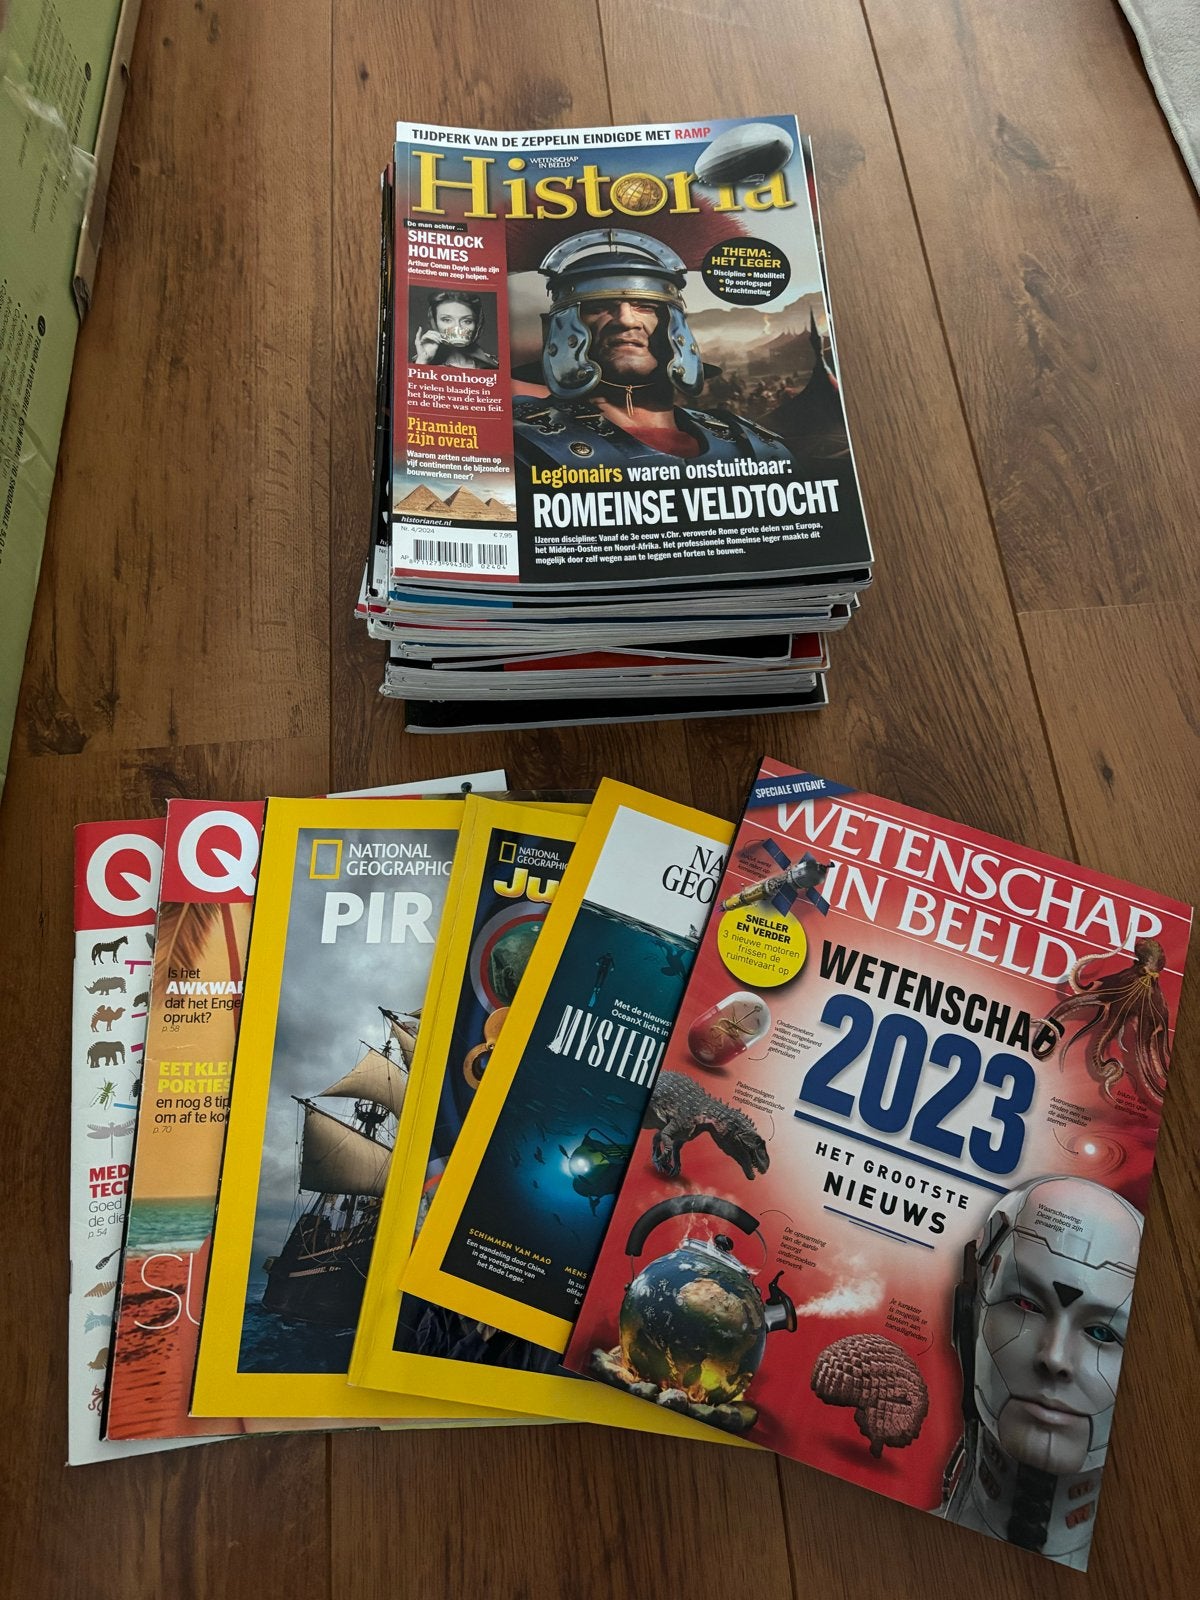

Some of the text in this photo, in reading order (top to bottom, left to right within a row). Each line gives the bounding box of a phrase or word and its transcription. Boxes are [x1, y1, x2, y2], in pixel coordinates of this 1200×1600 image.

[412, 127, 711, 147] TIJDPERK VAN DE ZEPPELIN EINDIGDE MET RAMP
[411, 150, 796, 220] Historia
[408, 230, 484, 249] SHERLOCK
[408, 245, 469, 262] HOLMES
[722, 247, 771, 258] THEMA:
[712, 257, 781, 269] HET LEGER
[714, 270, 746, 278] Discipline
[725, 279, 772, 288] Op oorlogspad
[726, 287, 771, 297] Krachtmeting
[408, 368, 497, 387] Pink omhoog!
[407, 390, 420, 398] het
[423, 391, 445, 401] kopje
[464, 395, 475, 403] de
[420, 383, 445, 392] vielen
[446, 386, 480, 396] blaadjes
[408, 417, 478, 436] Piramiden
[408, 431, 479, 449] zijn overal
[531, 458, 792, 489] Legionairs waren onstuitbaar:
[533, 479, 839, 528] ROMEINSE VELDTOCHT
[401, 516, 452, 526] historianet.nl
[534, 536, 560, 544] IJzeren
[561, 535, 598, 545] discipline:
[599, 534, 619, 542] Vanaf
[630, 533, 640, 541] 3e
[661, 531, 681, 539] v.Chr.
[682, 528, 717, 538] veroverde
[718, 528, 739, 536] Rome
[740, 525, 759, 535] grote
[761, 524, 780, 532] delen
[795, 522, 823, 530] Europa,
[535, 531, 821, 554] het Midden-Oosten en Noord-Afrika. Het professionele Romeinse leger maakte dit
[535, 556, 566, 566] mogelijk
[567, 555, 583, 564] door
[585, 555, 598, 563] zelf
[600, 555, 622, 564] wegen
[648, 551, 672, 561] leggen
[683, 547, 706, 558] forten
[707, 548, 715, 556] te
[716, 547, 746, 556] bouwen.
[755, 779, 826, 799] SPECIALE UITGAVE
[178, 810, 259, 896] Q
[349, 844, 432, 858] NATIONAL
[519, 846, 560, 861] NATIONAL
[347, 861, 453, 877] GEOGRAPHIC
[689, 845, 724, 879] NA
[87, 833, 164, 917] Q
[662, 865, 716, 904] GEO
[777, 799, 1162, 951] WETENSCHAP
[493, 867, 559, 904] Ju
[321, 892, 436, 944] PIR
[746, 914, 788, 933] SNELLER
[822, 859, 1077, 984] IN BEELD
[737, 922, 791, 944] EN VERDER
[723, 930, 800, 959] 3 nieuwe motoren
[726, 951, 790, 976] ruimtevaart op
[738, 945, 781, 964] frissen de
[168, 968, 201, 979] Is het
[165, 998, 185, 1009] dat
[188, 997, 209, 1010] het
[614, 999, 631, 1012] Met
[631, 1007, 642, 1016] de
[163, 1011, 212, 1028] oprukt?
[611, 1009, 669, 1037] OceanX licht in
[159, 1061, 192, 1076] EET
[799, 994, 1036, 1175] 2023
[156, 1098, 172, 1109] en
[175, 1098, 200, 1111] nog
[204, 1096, 212, 1108] 8
[155, 1113, 176, 1124] om
[180, 1111, 192, 1123] af
[194, 1112, 207, 1123] te
[89, 1164, 130, 1182] MED
[815, 1141, 969, 1210] HET GROOTSTE
[88, 1198, 122, 1213] Goed
[823, 1171, 947, 1235] NIEUWS
[88, 1215, 105, 1228] de
[468, 1228, 552, 1265] SCHIMMEN VAN MAO
[466, 1239, 546, 1275] Een wandeling door China,
[479, 1252, 488, 1260] de
[488, 1256, 523, 1275] voetsporen
[524, 1271, 536, 1279] van
[477, 1261, 525, 1284] het Rode Leger.
[564, 1266, 588, 1279] MENS
